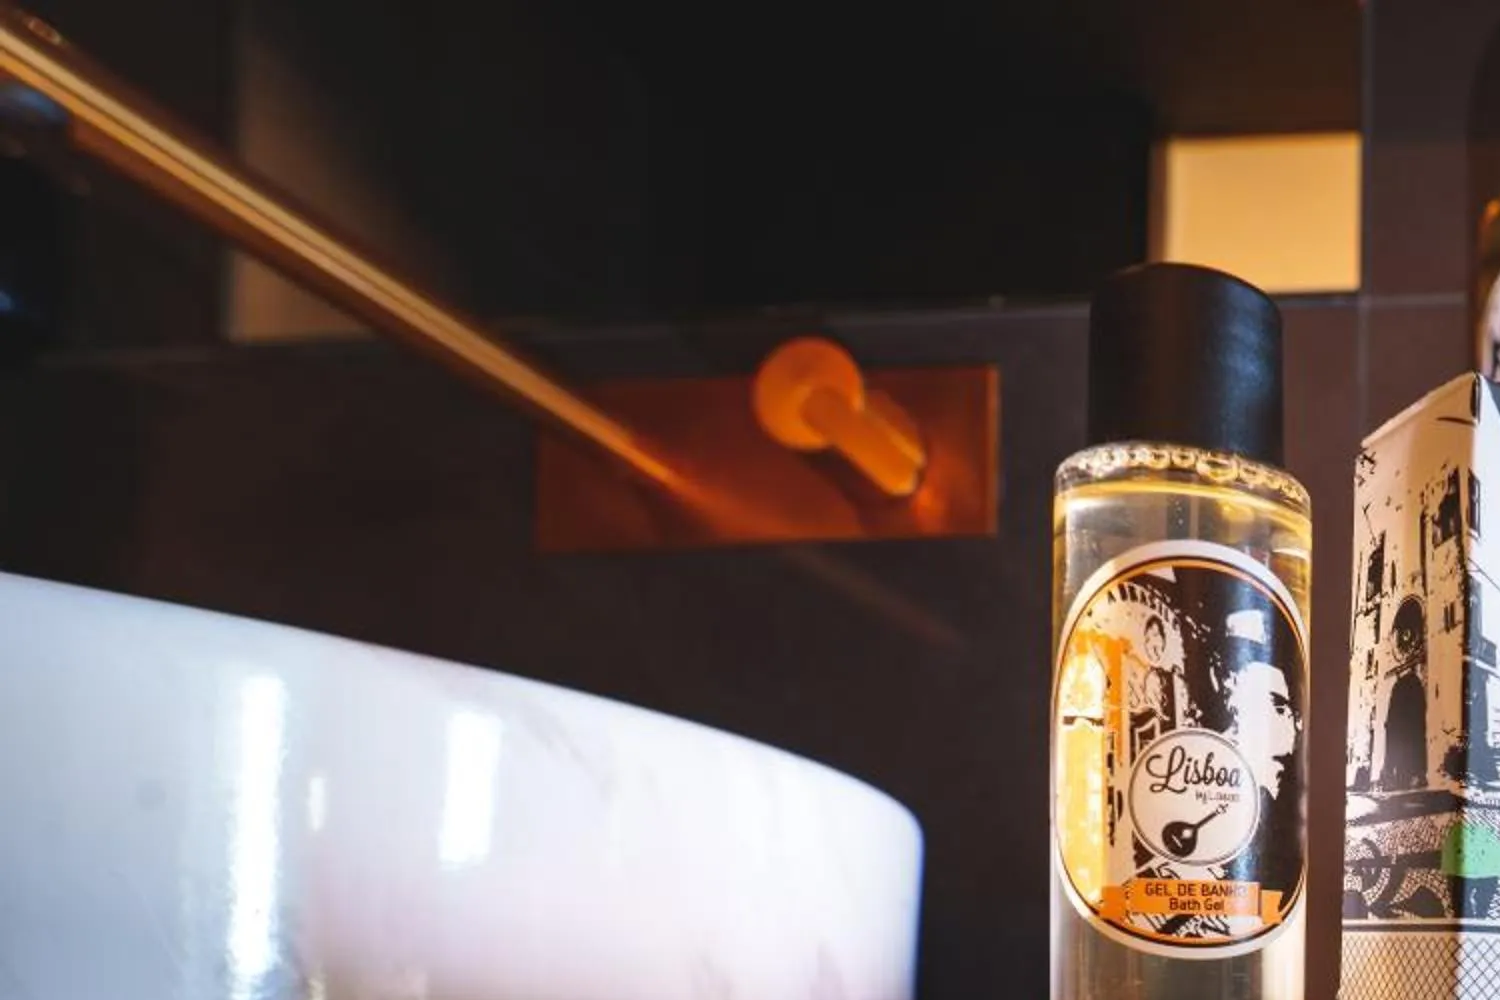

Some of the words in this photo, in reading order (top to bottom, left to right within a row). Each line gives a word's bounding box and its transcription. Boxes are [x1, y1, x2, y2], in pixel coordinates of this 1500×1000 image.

[1145, 745, 1241, 795] Lisboa
[1145, 883, 1172, 897] GEL
[1177, 883, 1197, 897] DE
[1169, 897, 1201, 911] Bath
[1203, 898, 1225, 911] Gel
